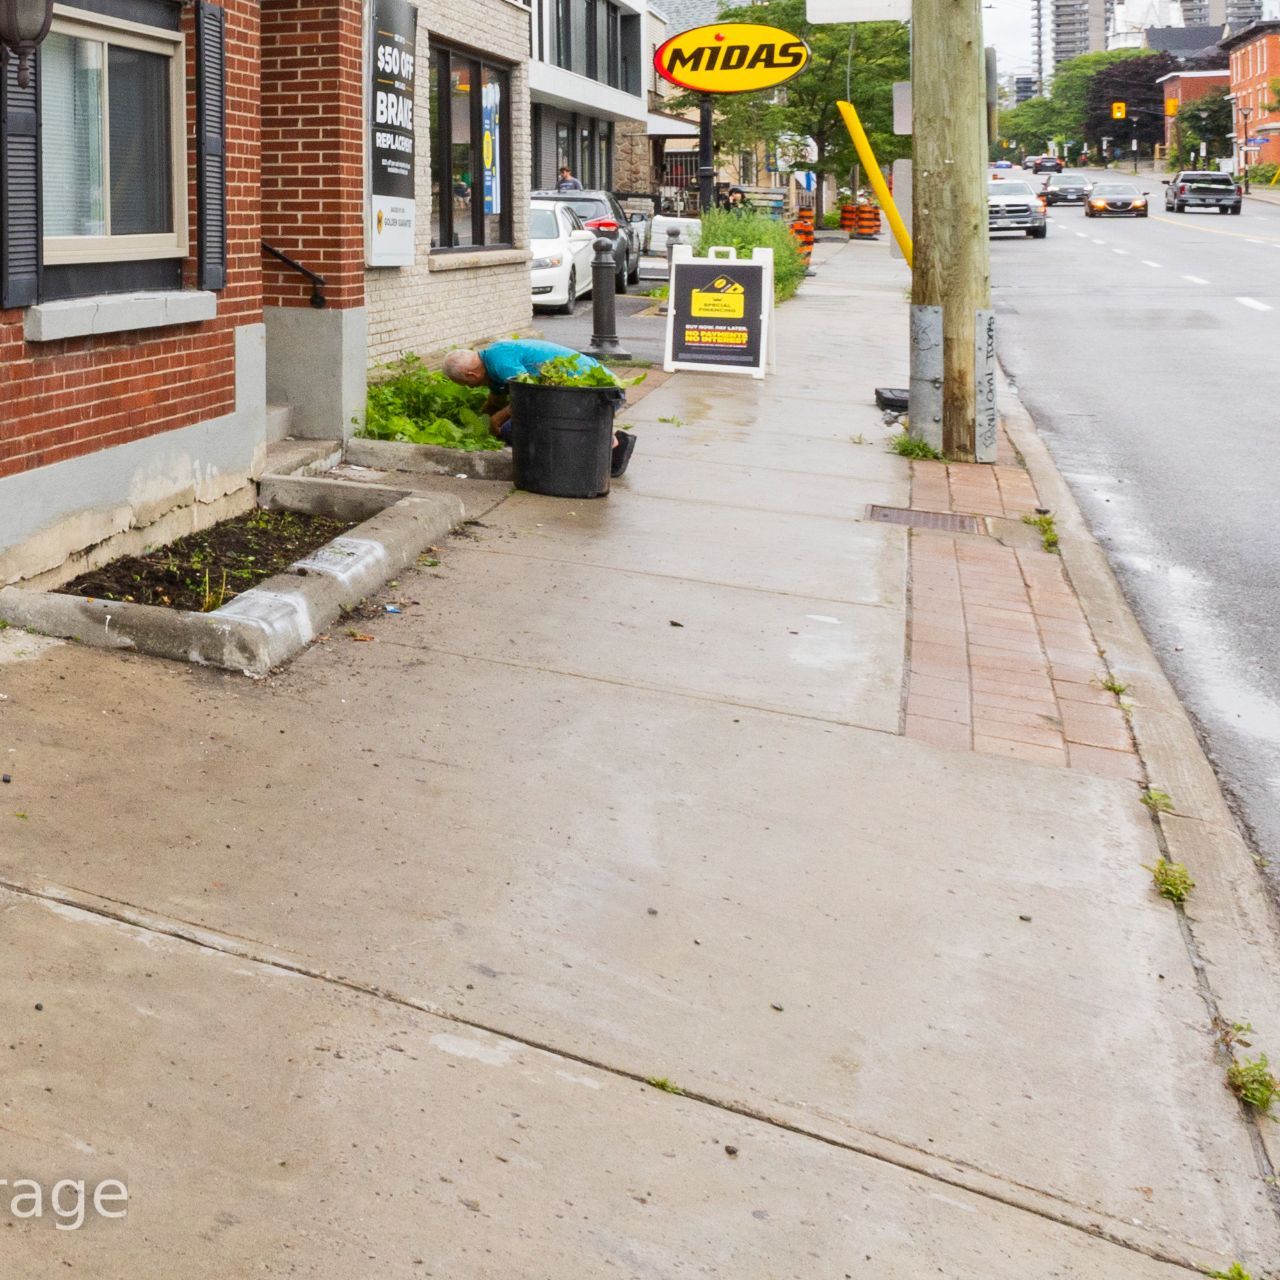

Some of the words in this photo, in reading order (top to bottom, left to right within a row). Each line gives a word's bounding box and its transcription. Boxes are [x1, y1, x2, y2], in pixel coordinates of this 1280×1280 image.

[377, 44, 399, 74] $50
[401, 51, 413, 81] OFF
[666, 40, 805, 75] MIDAS
[376, 91, 413, 131] BRAKE
